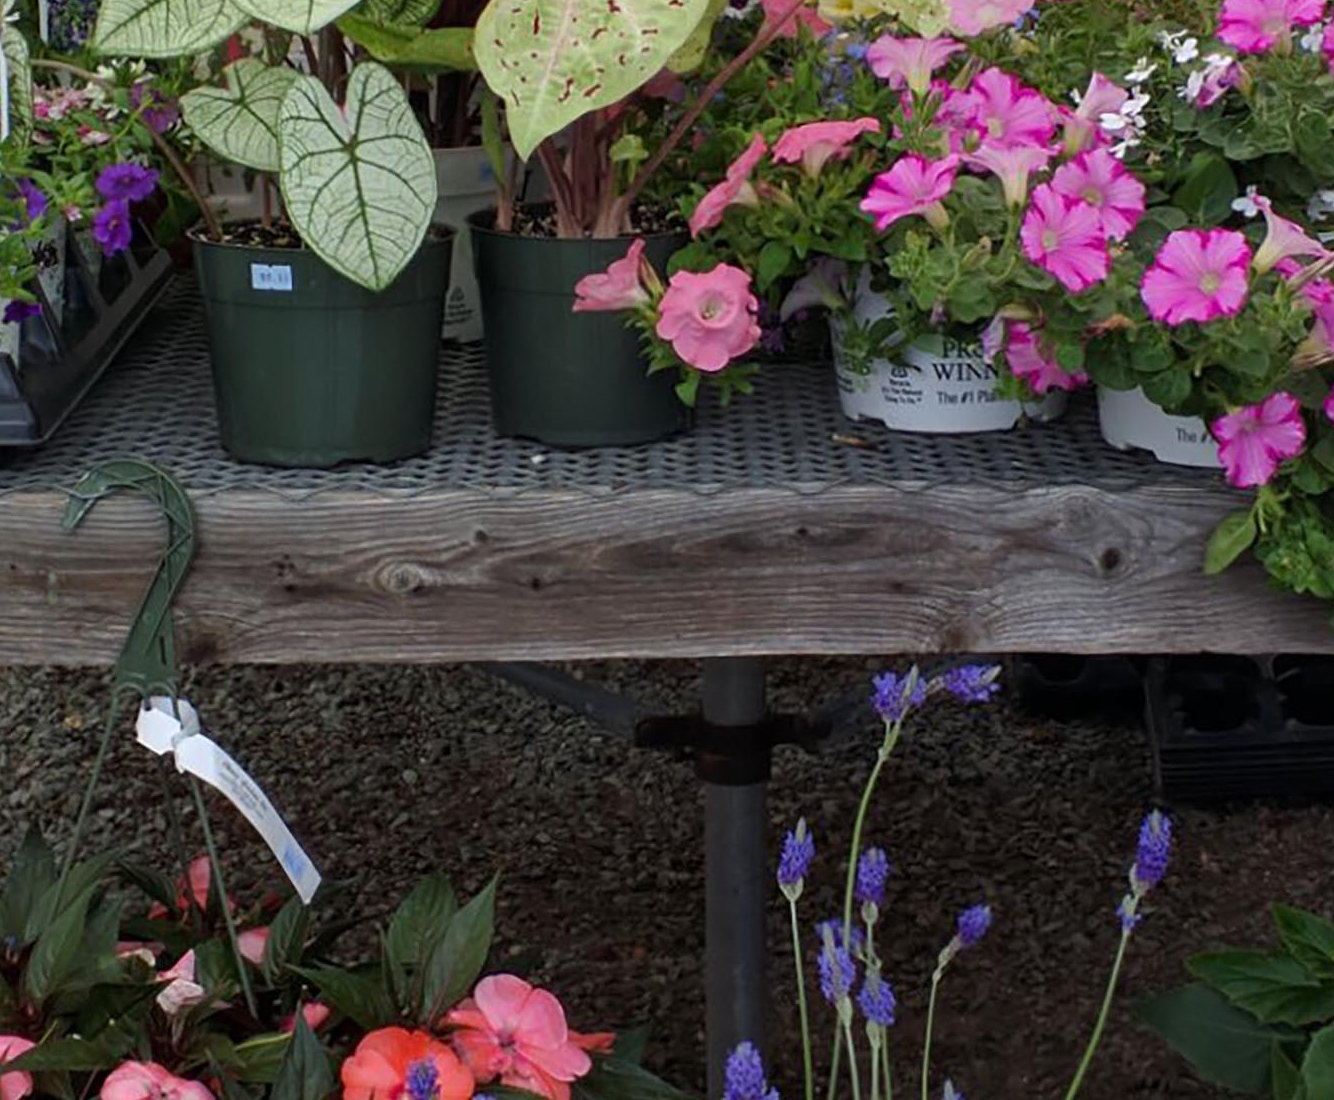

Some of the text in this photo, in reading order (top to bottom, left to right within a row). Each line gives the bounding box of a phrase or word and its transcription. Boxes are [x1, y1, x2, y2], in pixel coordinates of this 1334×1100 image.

[932, 362, 1000, 382] WINN
[936, 390, 958, 405] The
[1175, 426, 1198, 443] The
